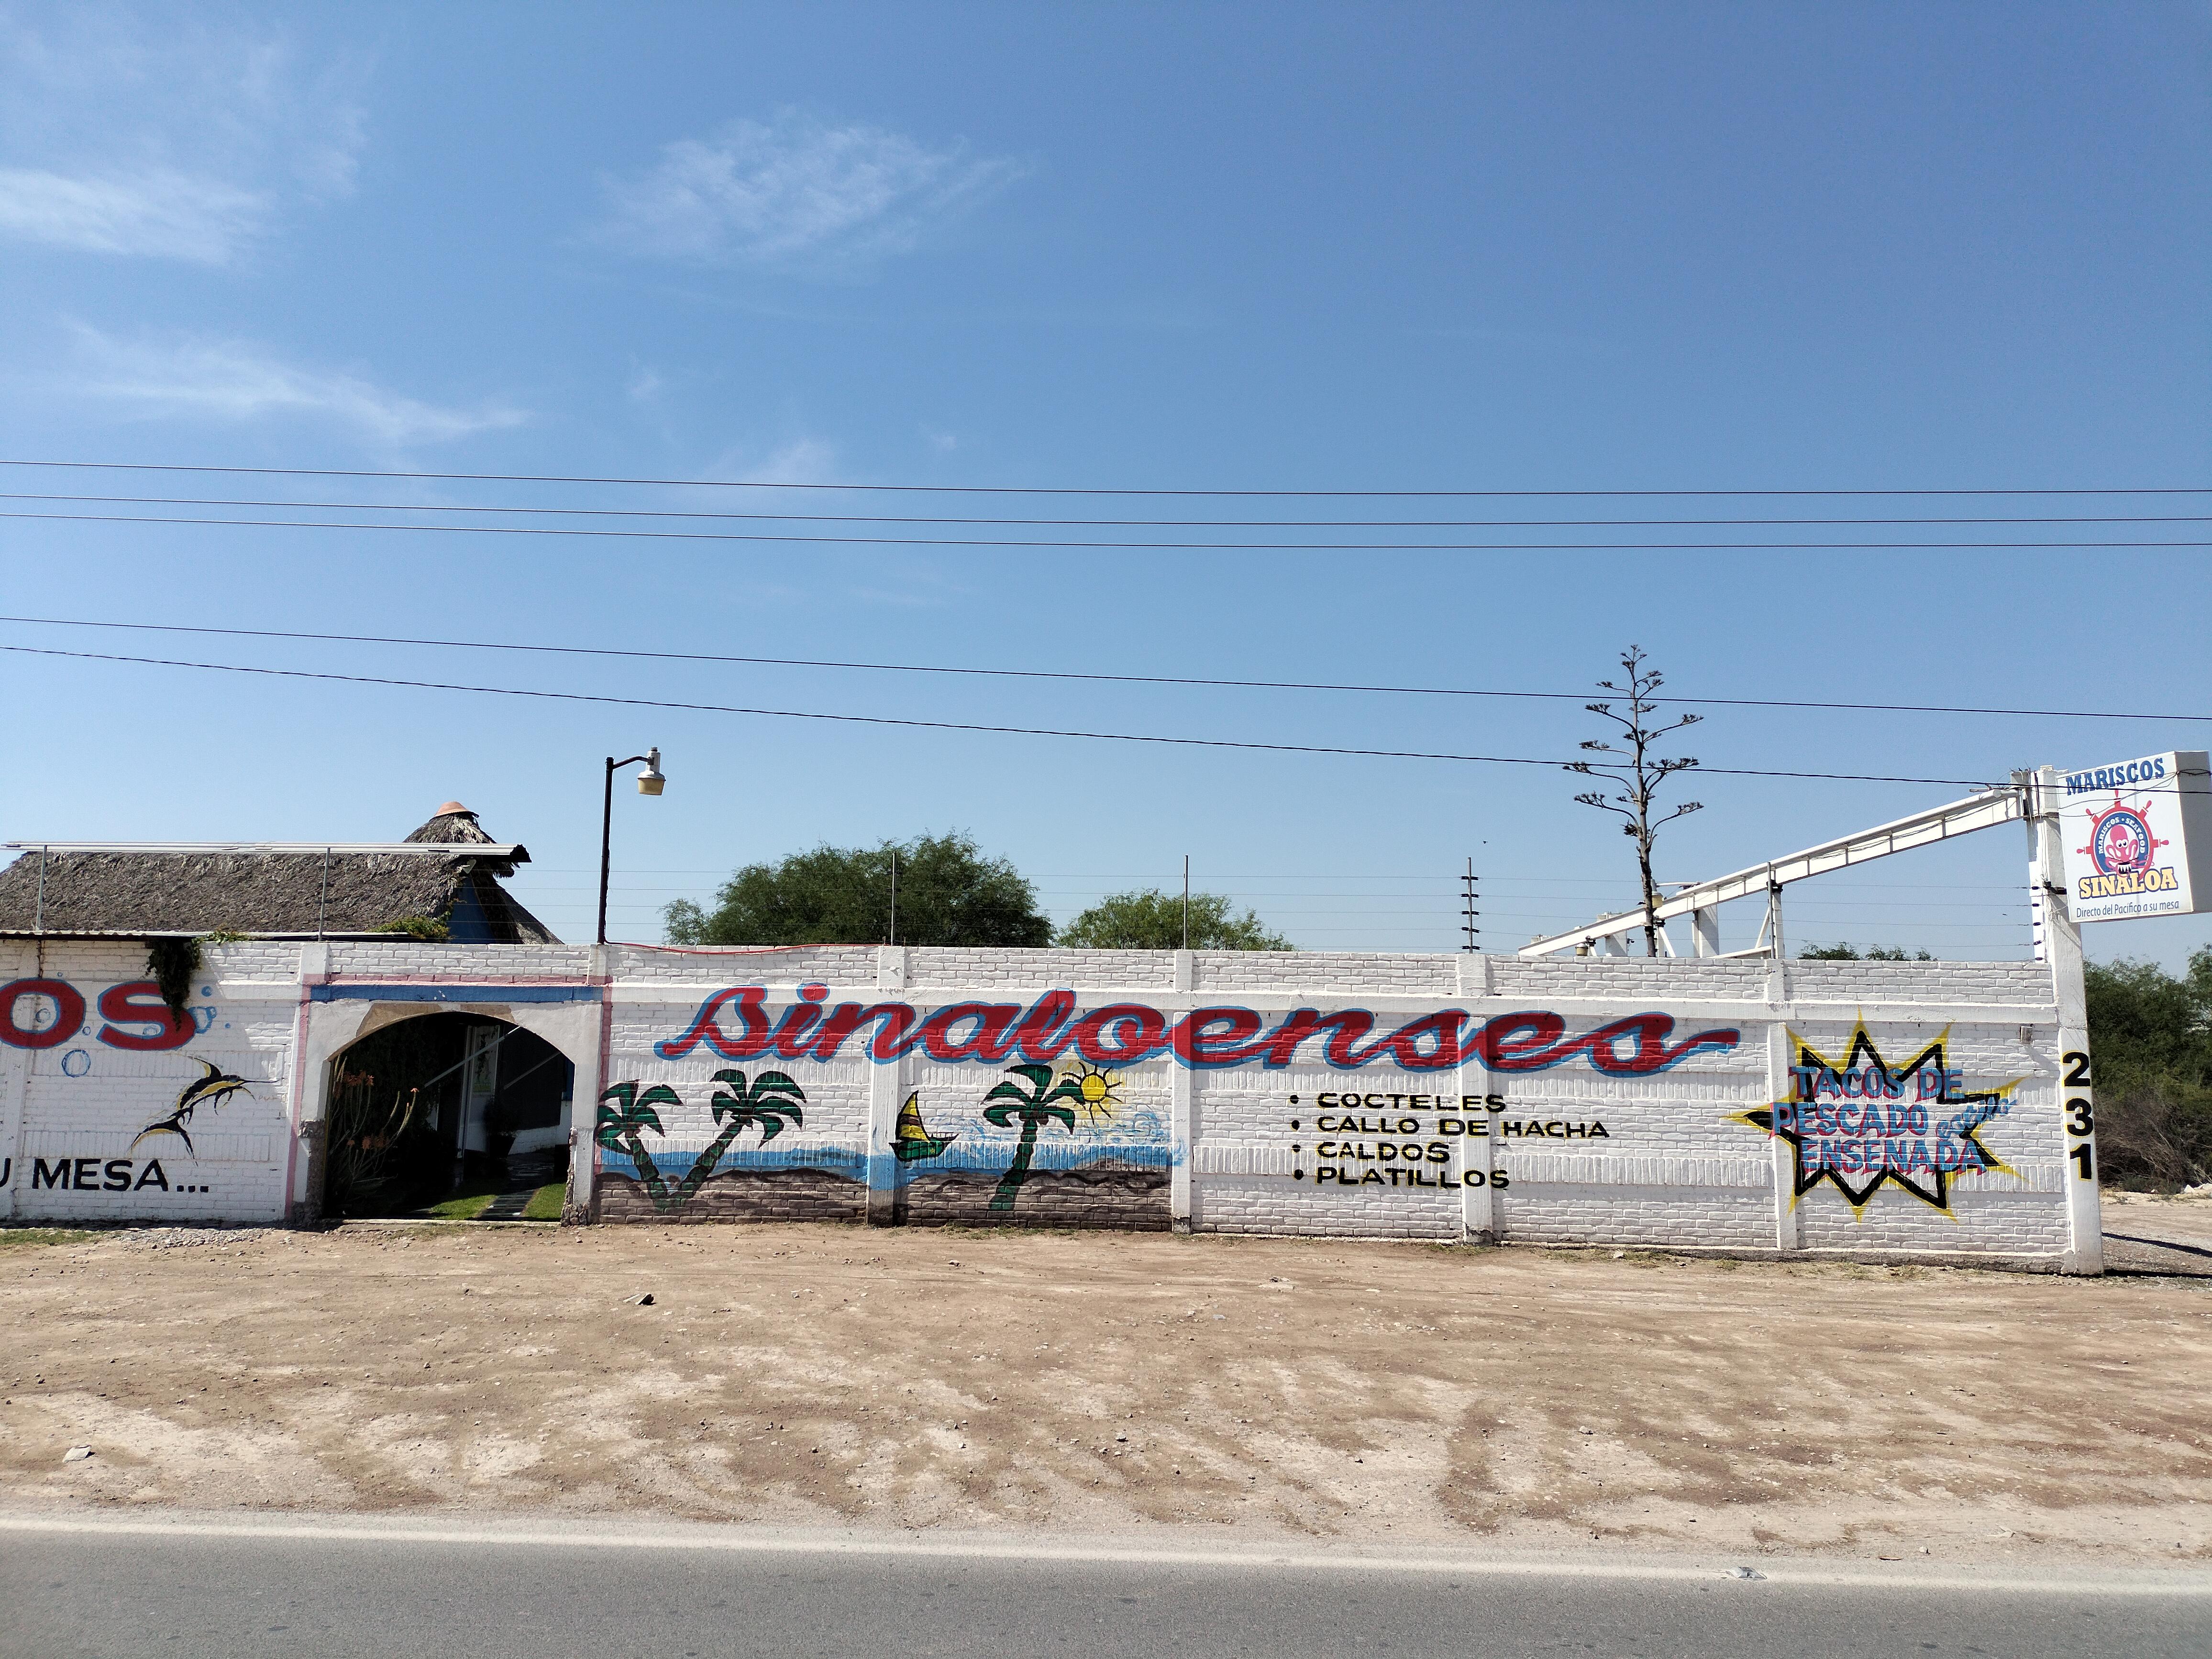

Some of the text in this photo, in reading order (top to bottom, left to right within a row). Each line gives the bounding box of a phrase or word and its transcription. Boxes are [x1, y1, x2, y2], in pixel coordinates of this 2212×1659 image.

[2066, 758, 2165, 796] MARISCOS
[2098, 817, 2145, 854] MARISCOS SEAFOOD
[2079, 866, 2179, 899] SINALOA
[2077, 907, 2101, 917] Directo
[2102, 904, 2112, 915] del
[2143, 904, 2148, 912] a
[2149, 903, 2157, 911] su
[2159, 901, 2179, 909] mesa
[1788, 1065, 1966, 1102] TACOS DE
[1316, 1093, 1506, 1113] COCTELES
[1316, 1116, 1610, 1139] CALLO DE HACHA
[1768, 1102, 1929, 1140] PESCADO
[1316, 1141, 1450, 1163] CALDOS
[1800, 1139, 1987, 1176] ENSENADA
[1316, 1166, 1510, 1190] PLATILLOS
